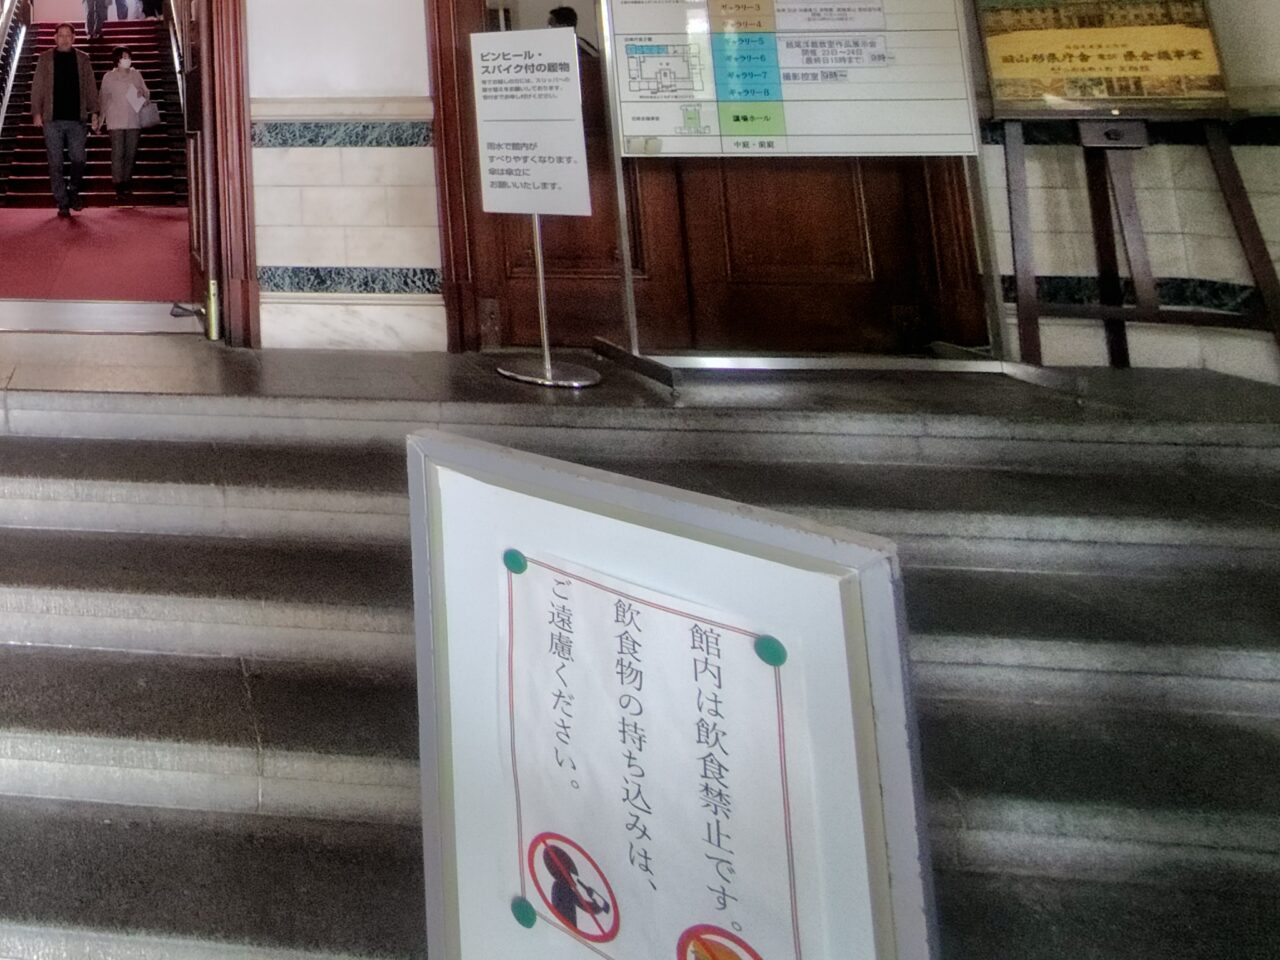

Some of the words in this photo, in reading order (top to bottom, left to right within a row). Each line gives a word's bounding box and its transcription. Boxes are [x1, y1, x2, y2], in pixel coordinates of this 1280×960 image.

[488, 155, 578, 164] すべりやすくなります。
[489, 180, 562, 190] お願いいたします。
[547, 578, 580, 790] ご遠慮ください。
[613, 598, 657, 891] 飲食物の持ち込みは、
[689, 623, 743, 932] 館内は飲食禁止です。
